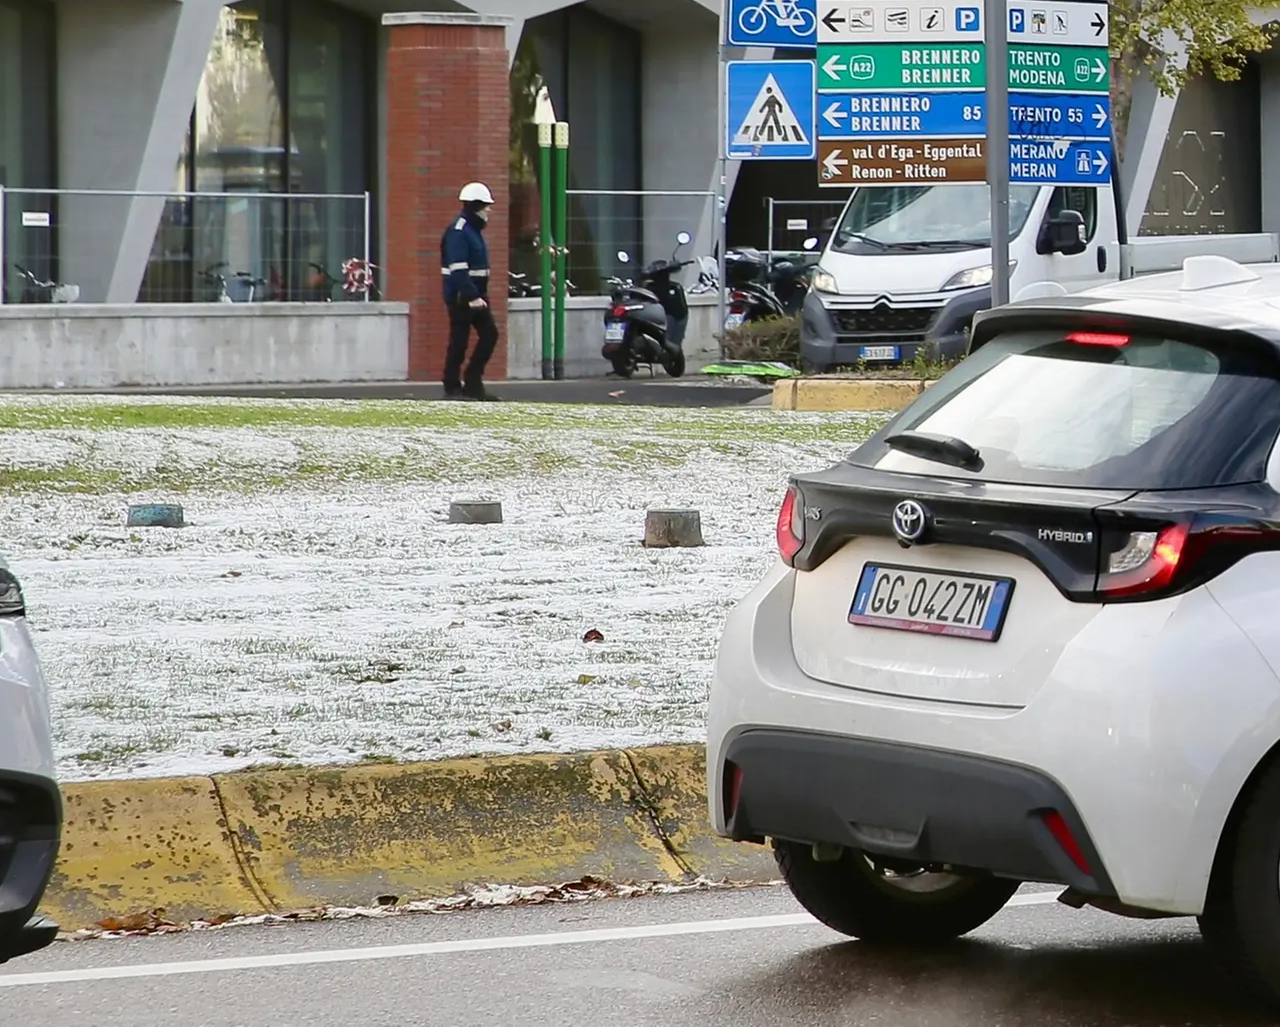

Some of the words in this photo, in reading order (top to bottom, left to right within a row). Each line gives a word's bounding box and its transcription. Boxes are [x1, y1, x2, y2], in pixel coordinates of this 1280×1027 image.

[901, 50, 980, 65] BRENNERO
[1009, 50, 1060, 66] TRENTO
[853, 62, 872, 72] A22
[1076, 65, 1088, 74] A22
[901, 69, 971, 83] BRENNER
[1009, 69, 1066, 85] MODENA
[851, 97, 930, 113] BRENNERO
[963, 106, 982, 121] 85
[1010, 106, 1062, 122] TRENTO
[1067, 109, 1083, 123] 55
[851, 116, 921, 131] BRENNER
[852, 144, 873, 159] val
[924, 143, 982, 161] Eggental
[1010, 144, 1066, 159] MERANO
[852, 164, 893, 179] Renon
[904, 163, 947, 178] Ritten
[1010, 162, 1057, 178] MERAN
[1038, 528, 1085, 543] HYBRID
[871, 573, 905, 615] GG
[908, 577, 991, 626] 042ZM
